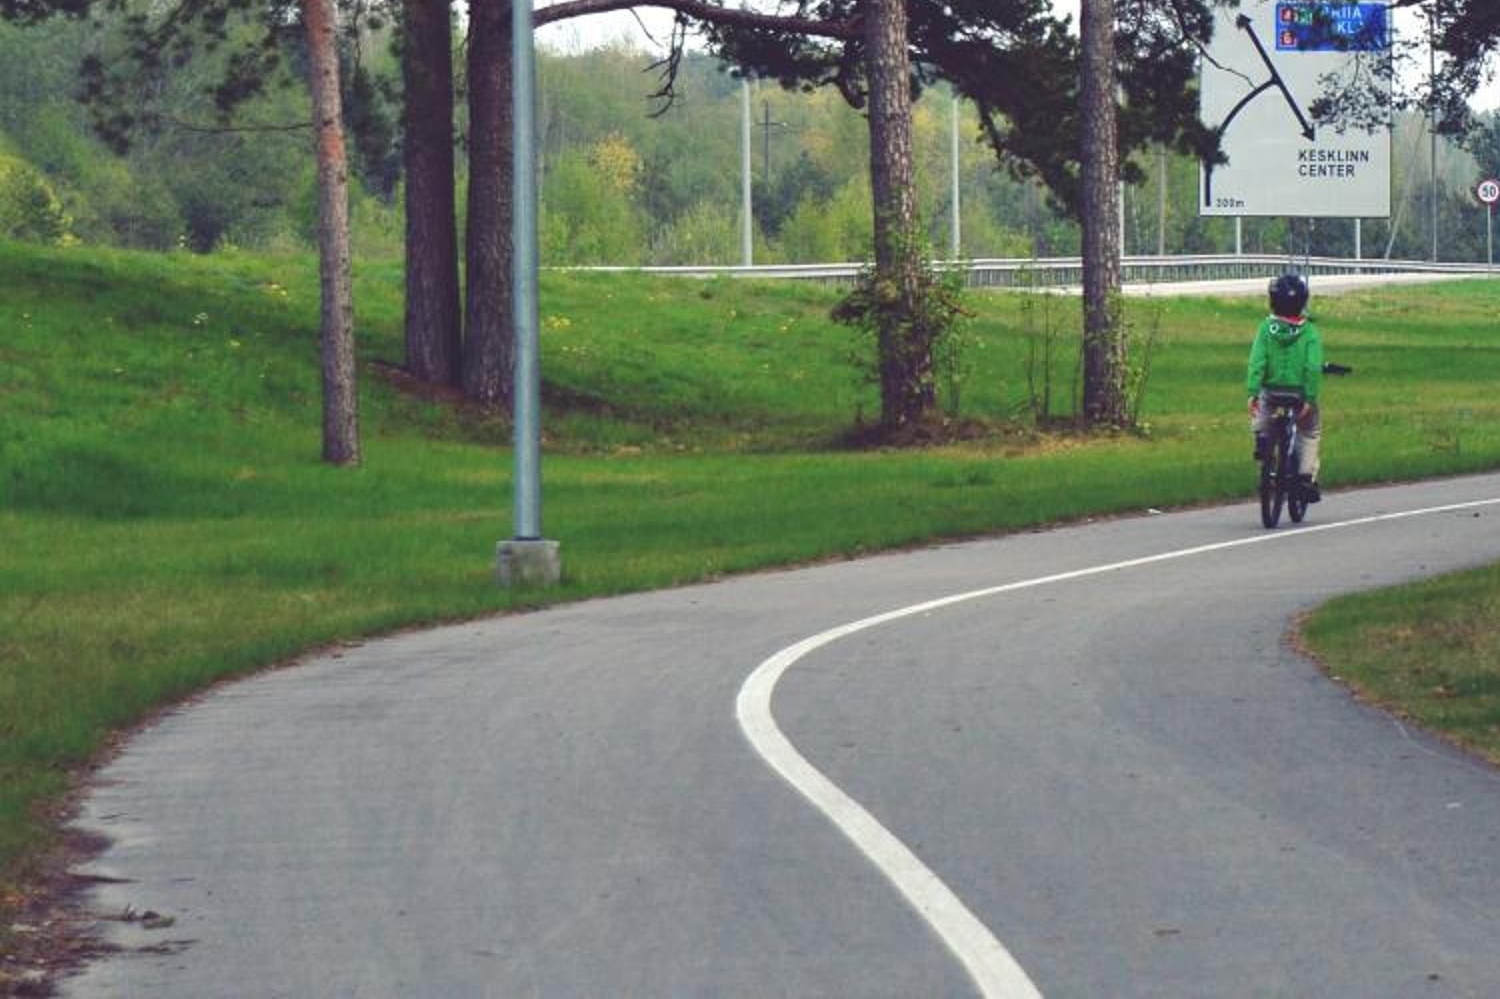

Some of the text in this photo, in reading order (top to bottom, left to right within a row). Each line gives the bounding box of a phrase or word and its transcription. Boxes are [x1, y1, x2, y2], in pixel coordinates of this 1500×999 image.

[1298, 149, 1369, 162] KESKLINN
[1298, 164, 1355, 177] CENTER
[1482, 185, 1496, 198] 50
